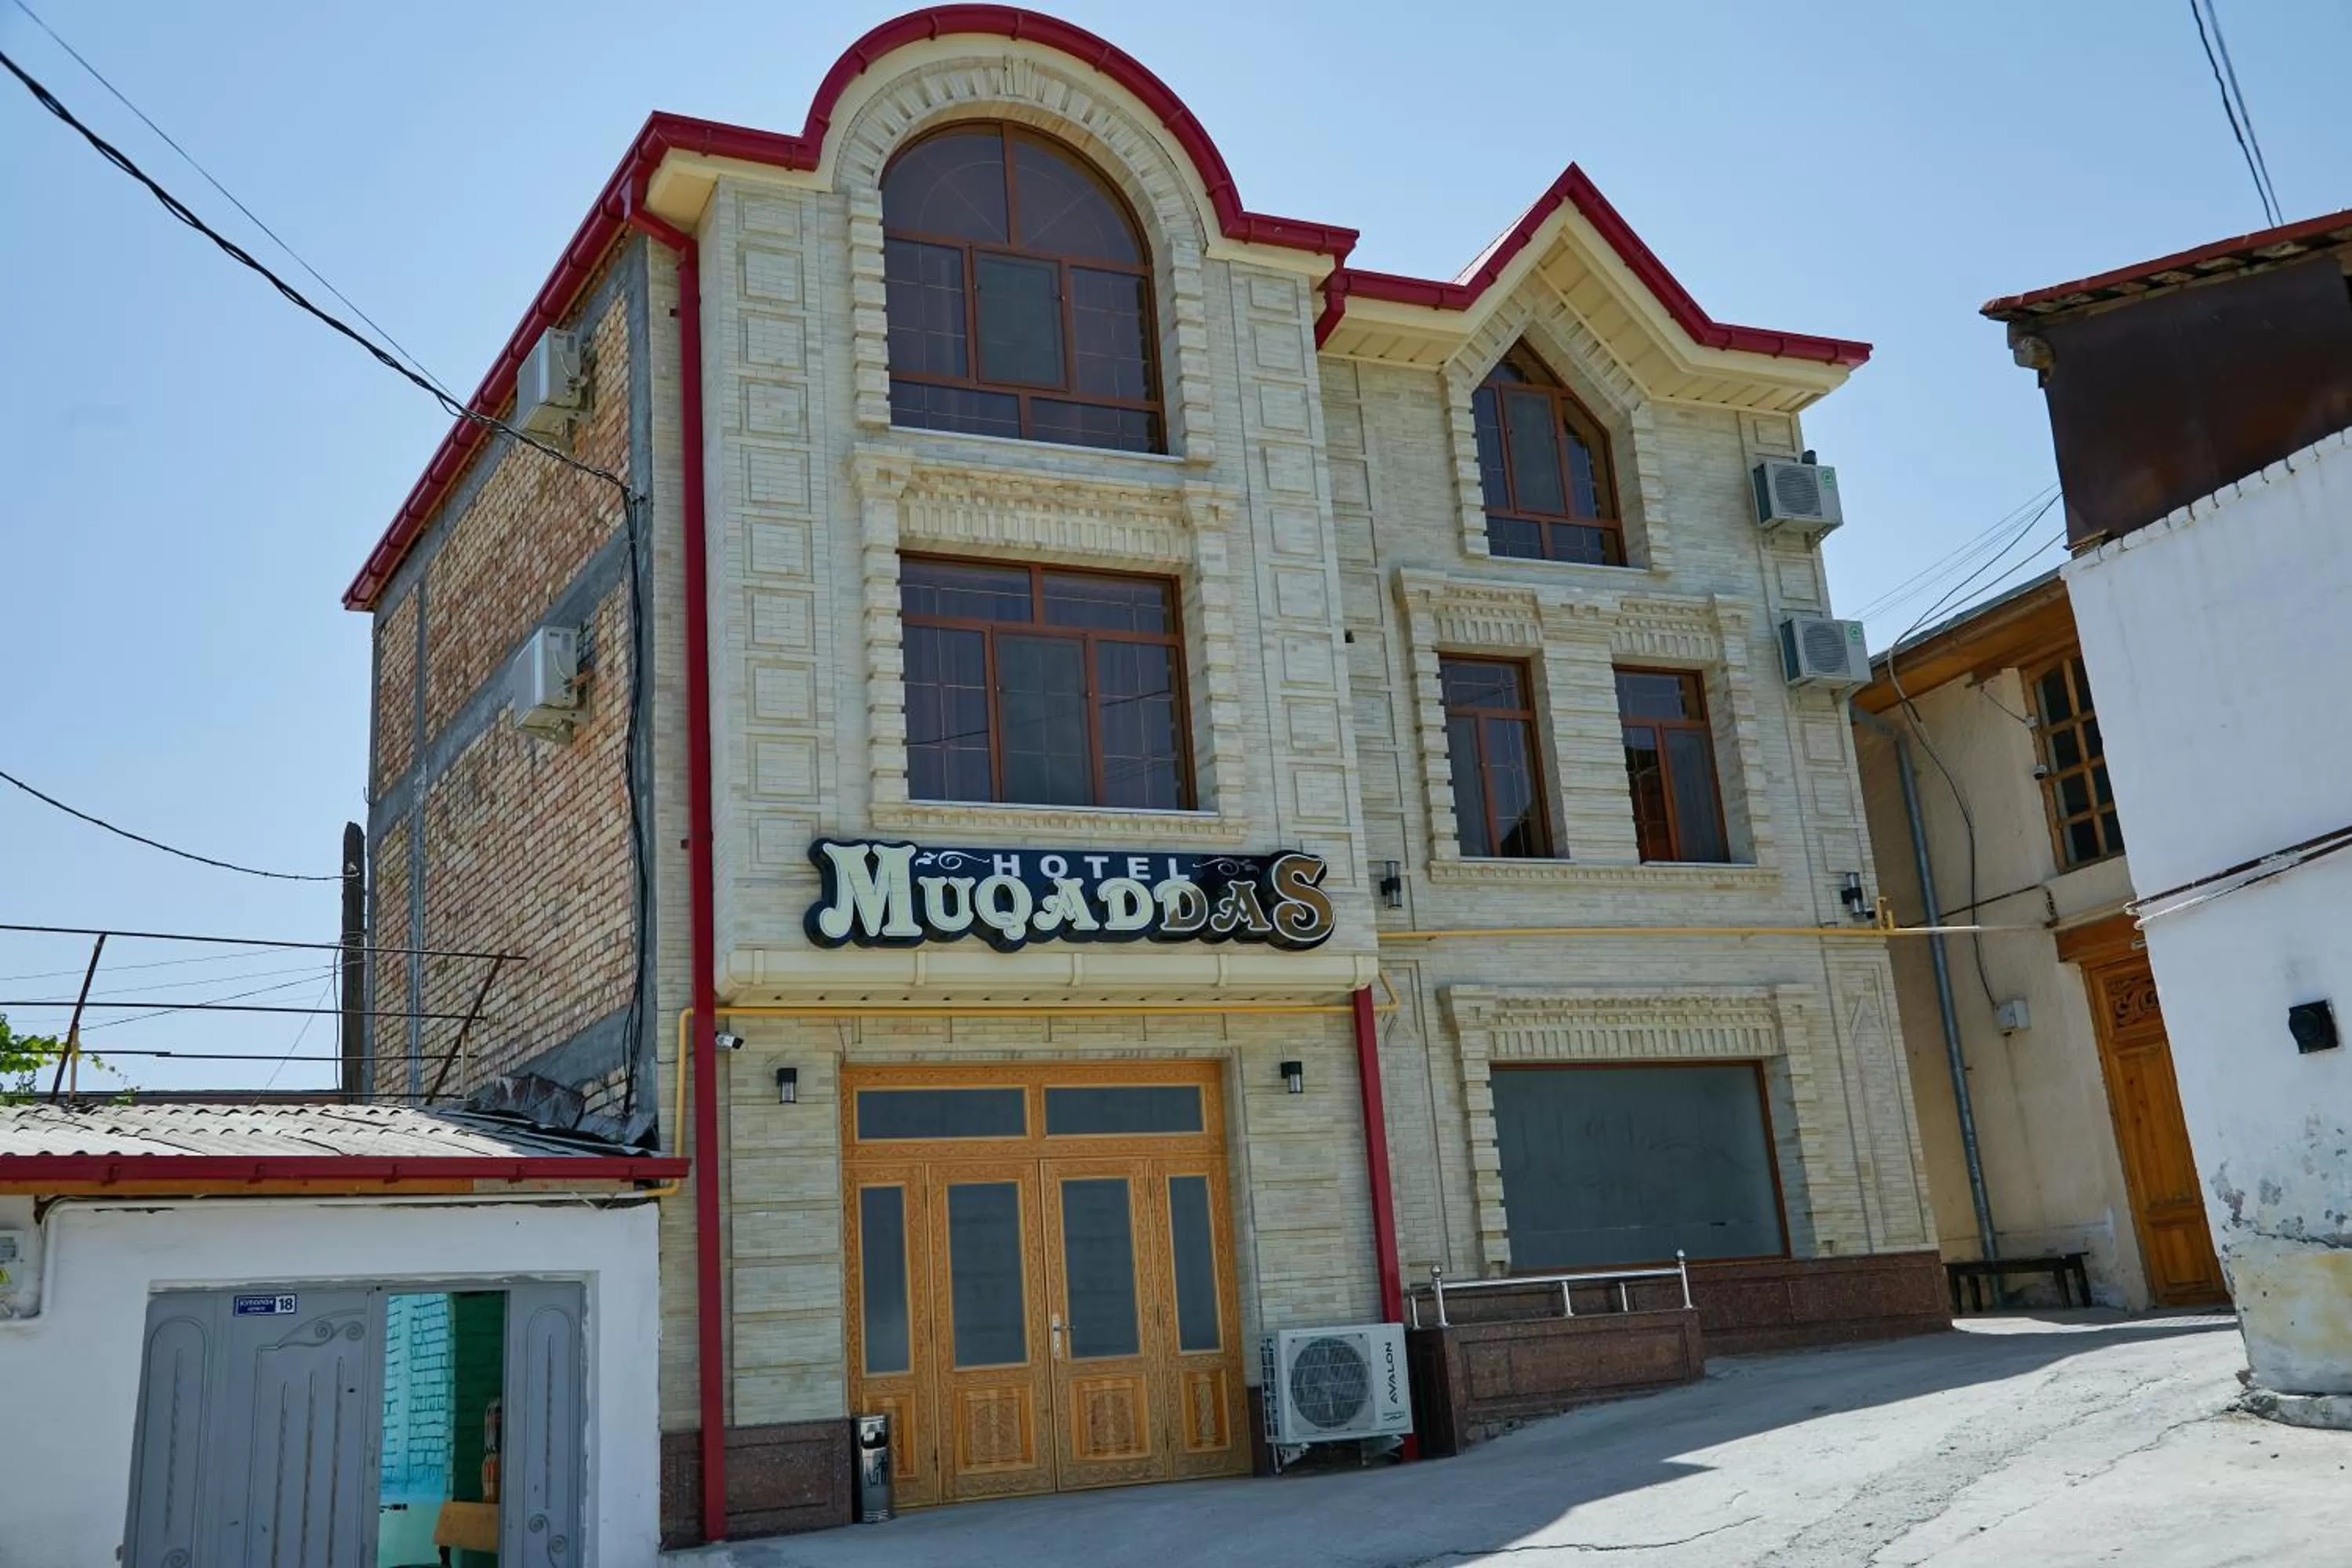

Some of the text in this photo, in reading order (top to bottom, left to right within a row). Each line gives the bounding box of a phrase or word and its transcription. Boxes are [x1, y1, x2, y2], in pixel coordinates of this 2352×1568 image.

[993, 853, 1192, 880] HOTEL
[818, 842, 1334, 941] MUQADDAS
[278, 1298, 293, 1311] 18
[1385, 1341, 1398, 1403] AVALON
